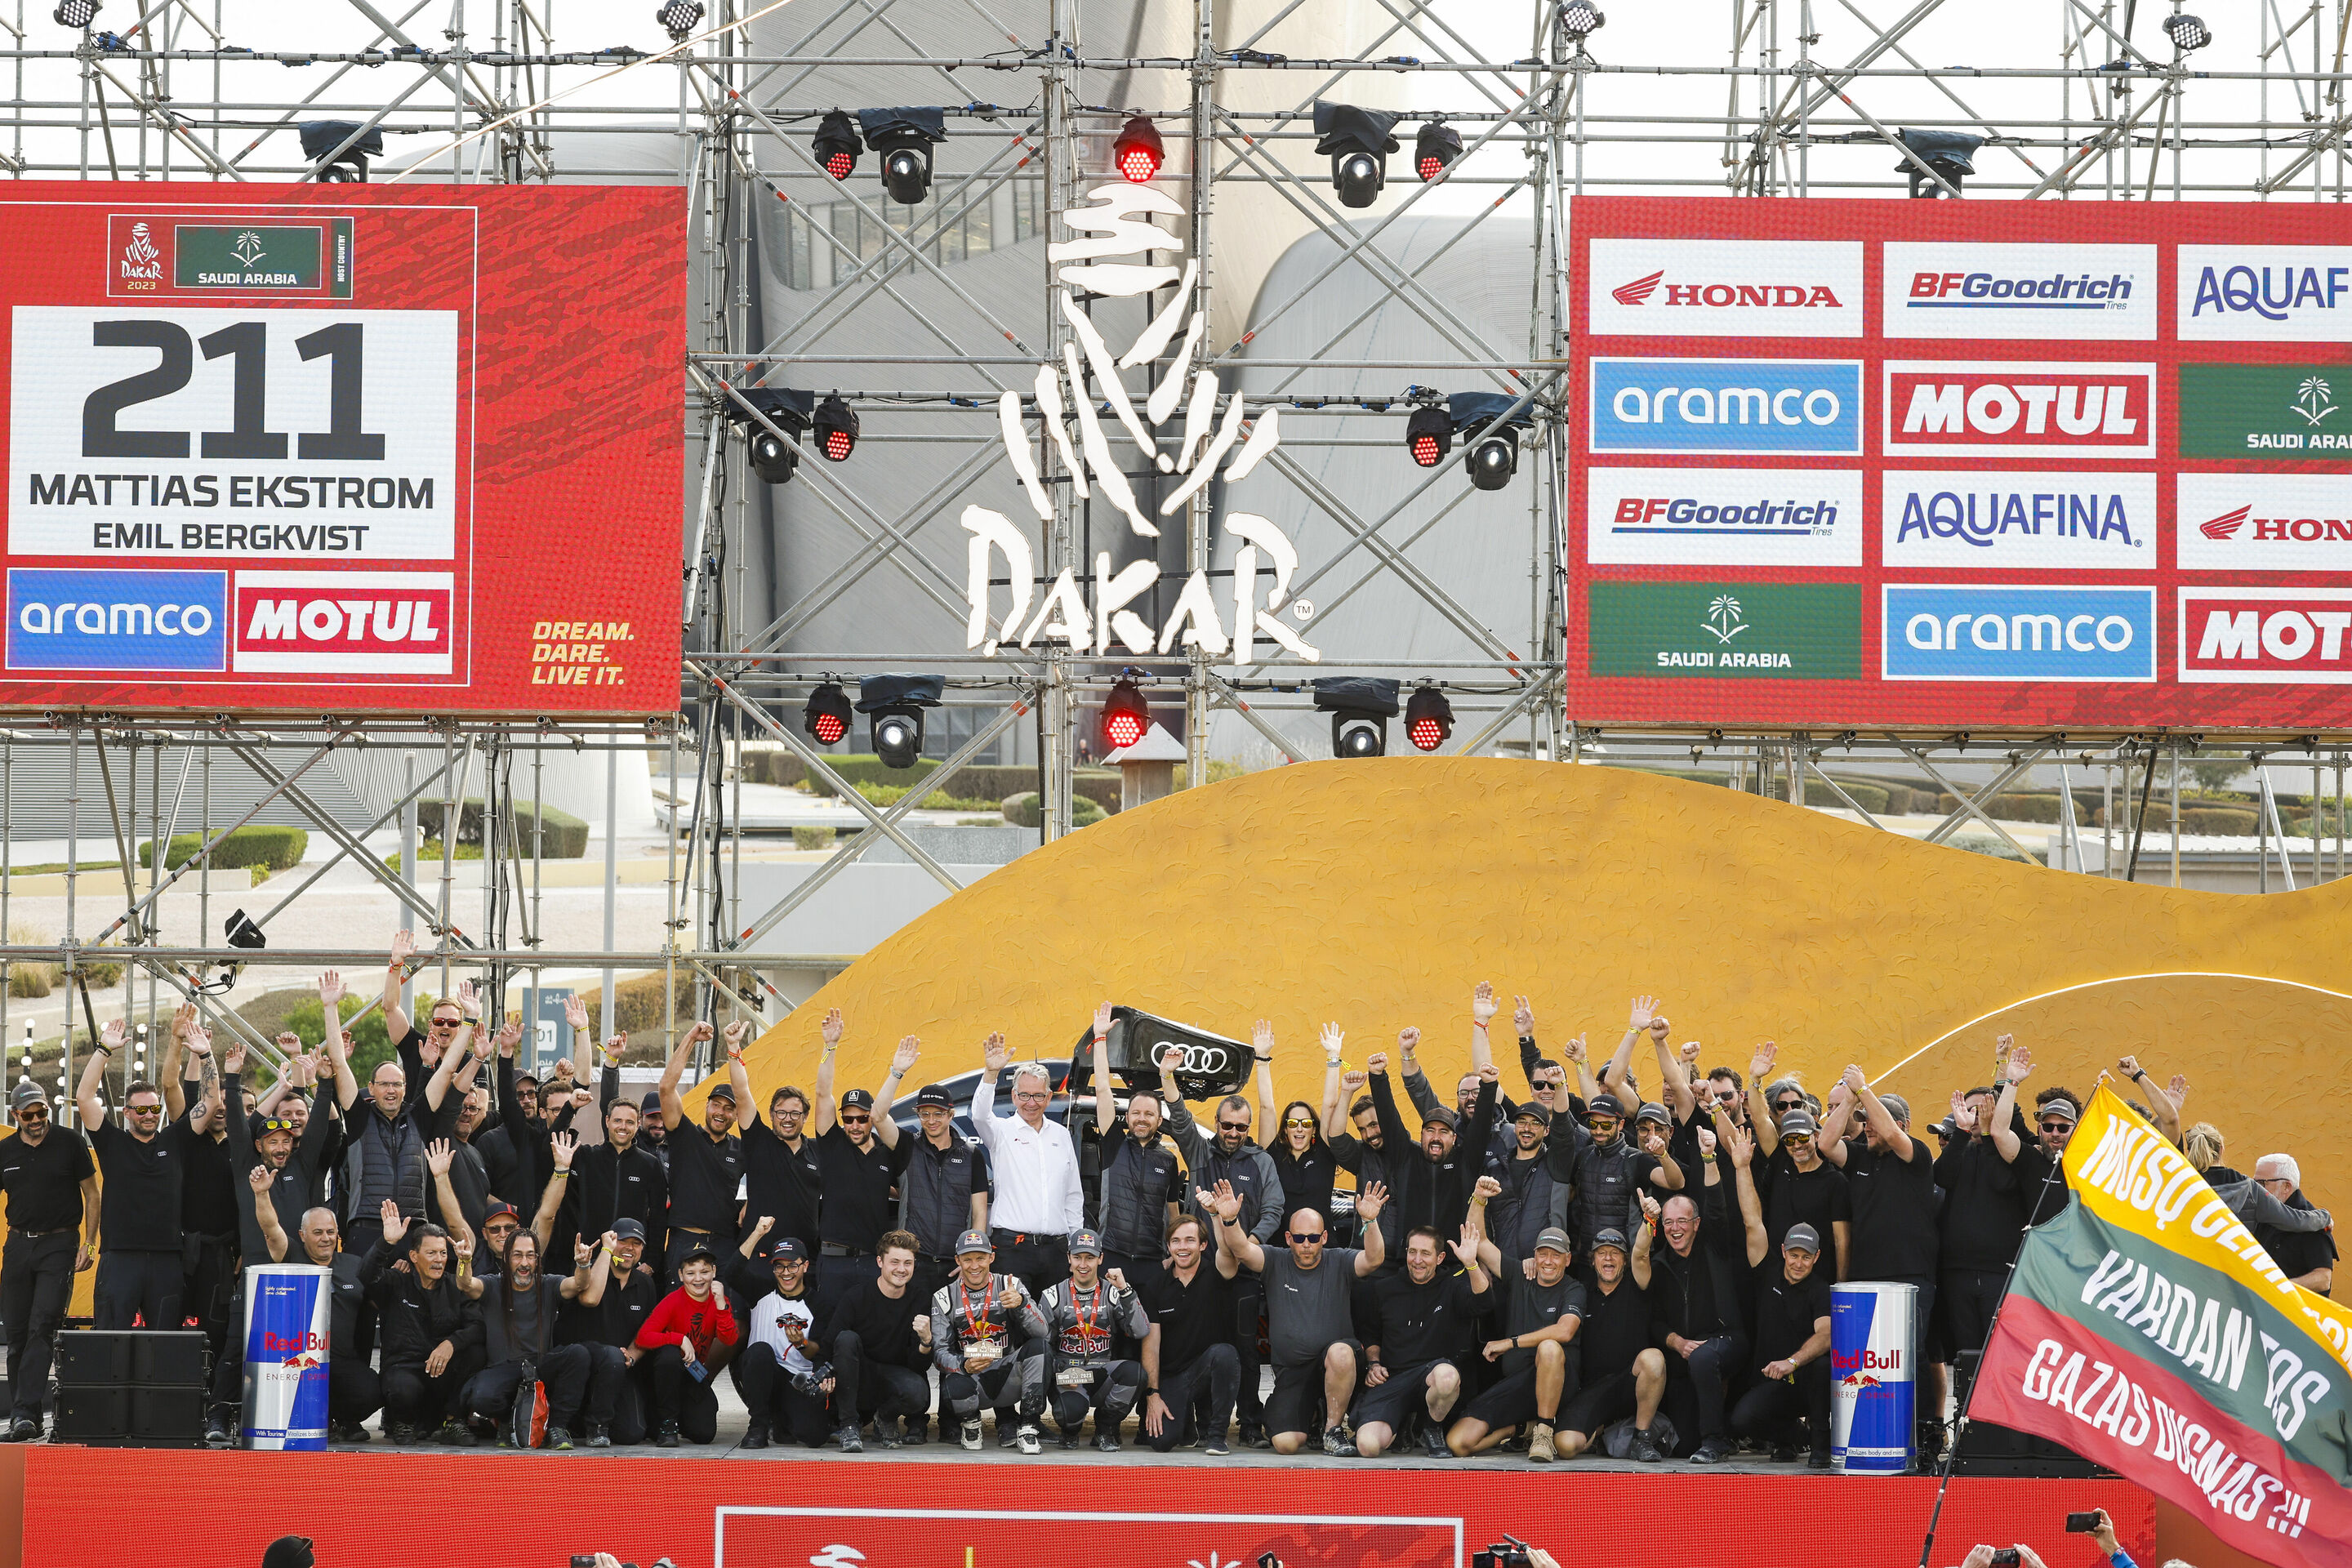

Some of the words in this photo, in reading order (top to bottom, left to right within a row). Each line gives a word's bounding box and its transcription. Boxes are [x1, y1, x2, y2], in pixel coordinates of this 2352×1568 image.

[337, 234, 345, 261] COUNTRY
[121, 260, 163, 279] DAKAR
[198, 273, 240, 284] SAUDI
[244, 273, 297, 284] ARABIA
[337, 262, 345, 283] HOST
[127, 281, 156, 290] 2023
[1665, 284, 1843, 307] HONDA
[1909, 273, 2132, 299] BFGoodrich
[2192, 265, 2349, 321] AQUAF
[2105, 301, 2127, 310] Tires
[81, 319, 386, 461] 211
[1613, 387, 1841, 426] aramco
[1901, 384, 2138, 435] MOTUL
[2247, 434, 2304, 449] SAUDI
[2309, 434, 2352, 449] ARA
[29, 474, 220, 509] MATTIAS
[229, 475, 434, 510] EKSTROM
[1614, 498, 1838, 525] BFGoodrich
[1897, 492, 2132, 547] AQUAFINA
[94, 523, 174, 550] EMIL
[181, 523, 369, 551] BERGKVIST
[1811, 527, 1833, 537] Tires
[960, 504, 1321, 665] DAKAR
[20, 602, 212, 637] aramco
[246, 599, 440, 642] MOTUL
[532, 621, 635, 641] DREAM.
[1905, 613, 2134, 653] aramco
[2197, 610, 2352, 661] MOT
[532, 644, 610, 662] DARE.
[1657, 652, 1713, 667] SAUDI
[1719, 653, 1792, 668] ARABIA
[531, 666, 591, 685] LIVE
[595, 666, 625, 685] IT.
[2080, 1249, 2252, 1392] VARDAN
[264, 1331, 303, 1351] Red
[306, 1332, 330, 1351] Bull
[1060, 1339, 1085, 1353] Red
[1088, 1339, 1110, 1352] Bull
[1832, 1349, 1860, 1370] Red
[1864, 1350, 1900, 1370] Bull
[266, 1373, 305, 1381] ENERGY
[2022, 1339, 2152, 1447] GAZAS
[2152, 1396, 2284, 1522] DUGNAS
